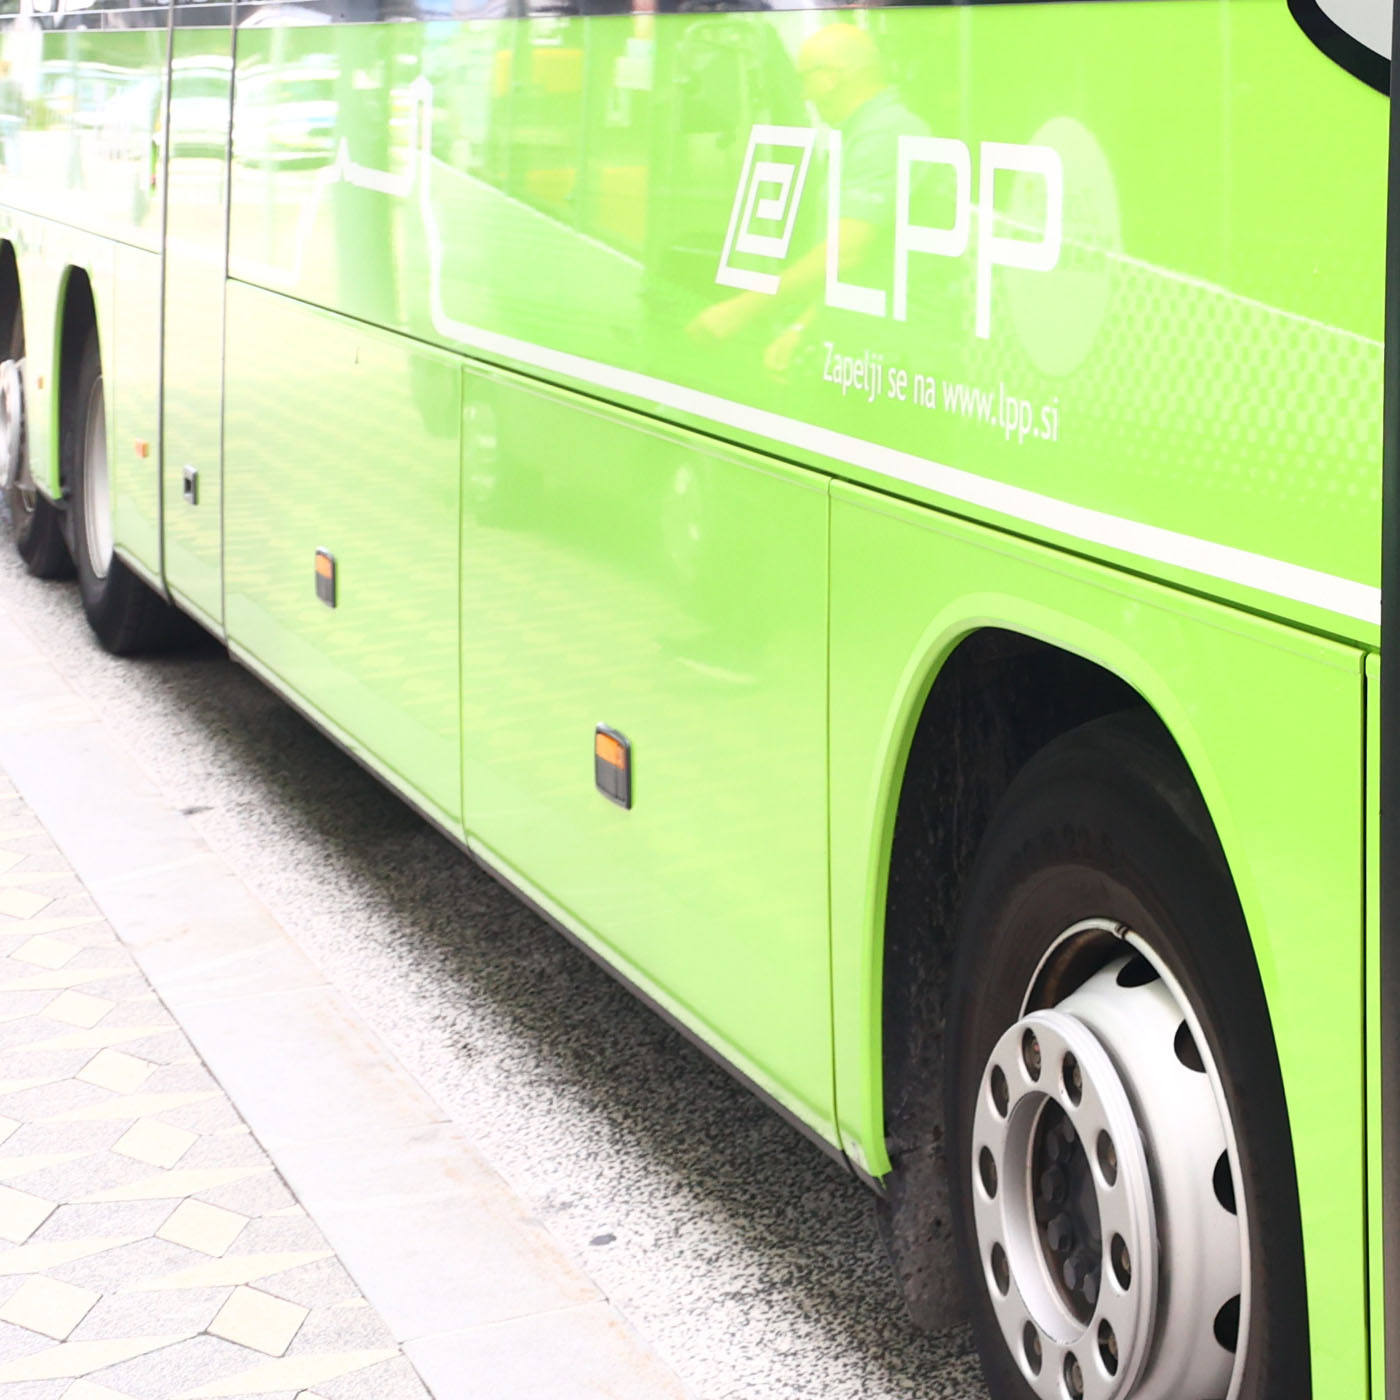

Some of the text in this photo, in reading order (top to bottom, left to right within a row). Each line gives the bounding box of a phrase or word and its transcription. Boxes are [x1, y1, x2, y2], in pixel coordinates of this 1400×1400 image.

[825, 128, 1064, 340] LPP
[823, 341, 1059, 445] Zapelji se na www.lpp.si
